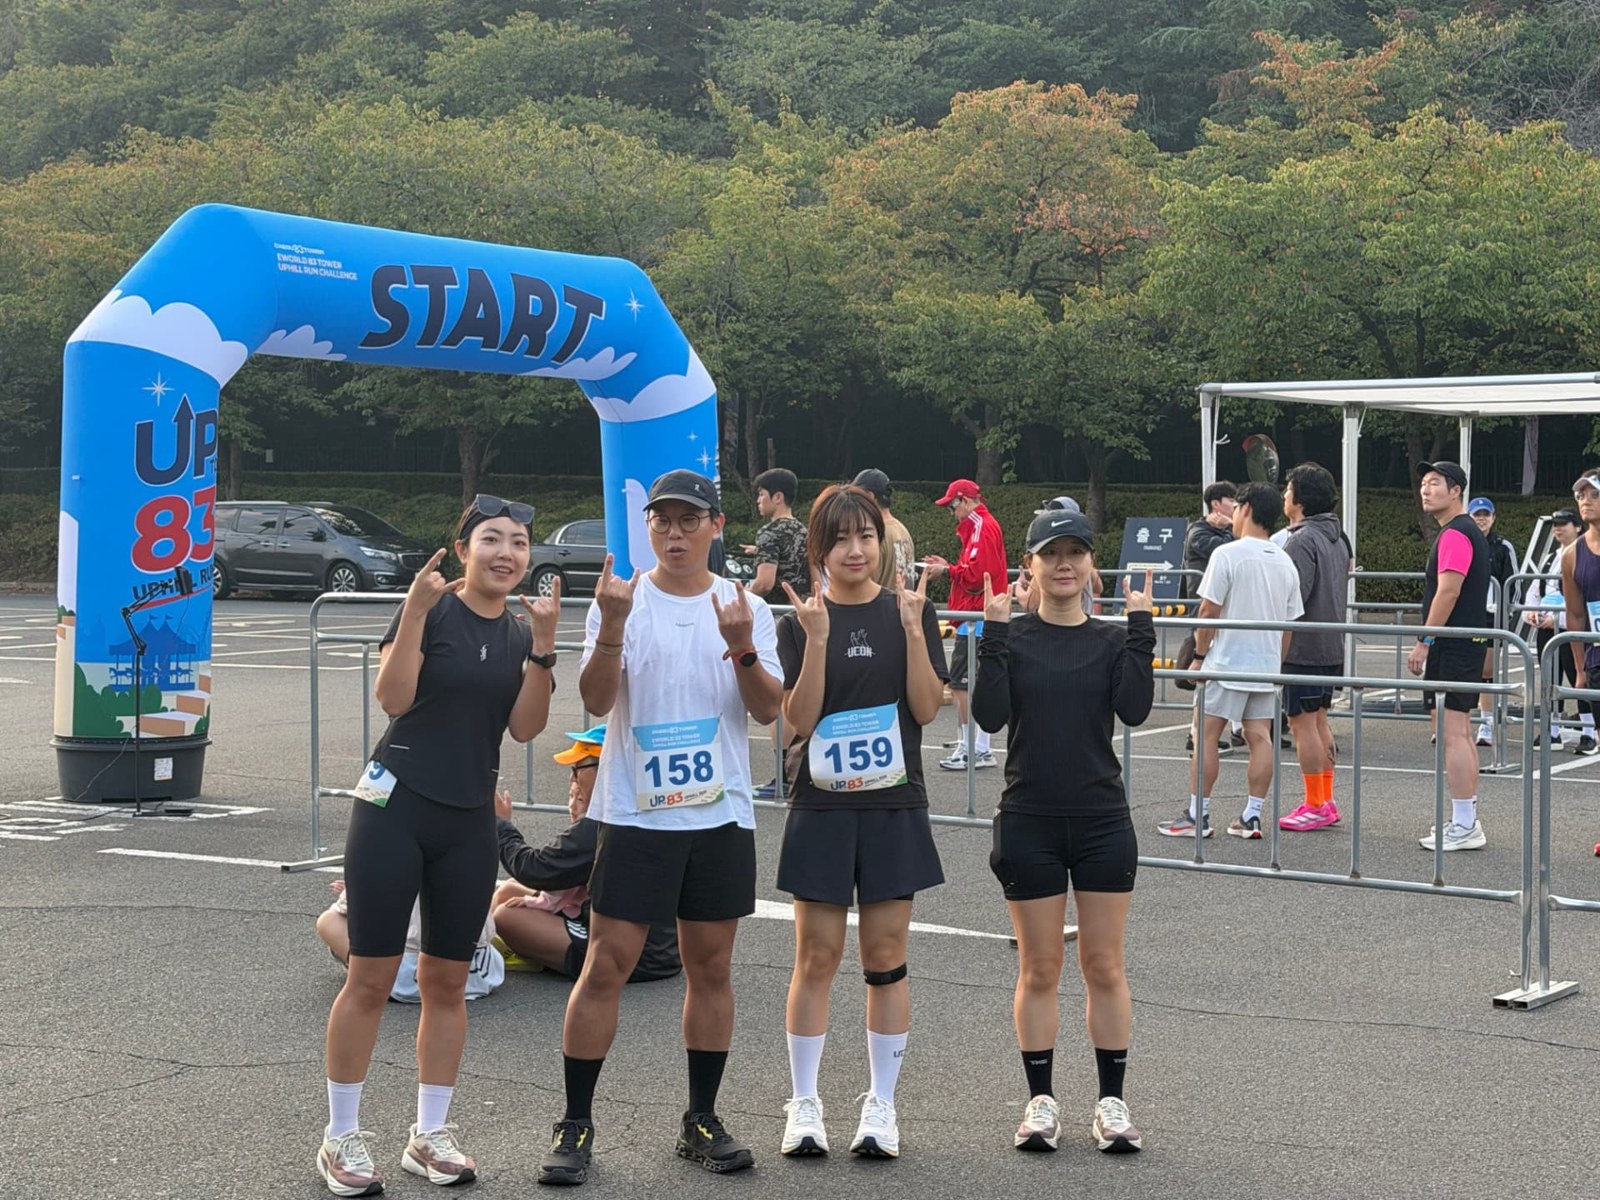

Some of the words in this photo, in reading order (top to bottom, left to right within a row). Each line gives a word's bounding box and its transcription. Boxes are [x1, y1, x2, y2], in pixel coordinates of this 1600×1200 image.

[278, 263, 303, 274] UPHILL
[304, 265, 318, 275] RUN
[319, 267, 358, 281] CHALLENGE
[318, 258, 342, 269] TOWER
[358, 264, 606, 365] START
[134, 393, 217, 487] UP
[131, 484, 217, 575] 83
[644, 750, 714, 788] 158
[824, 736, 893, 774] 159
[667, 791, 683, 806] 83
[847, 777, 864, 790] 83
